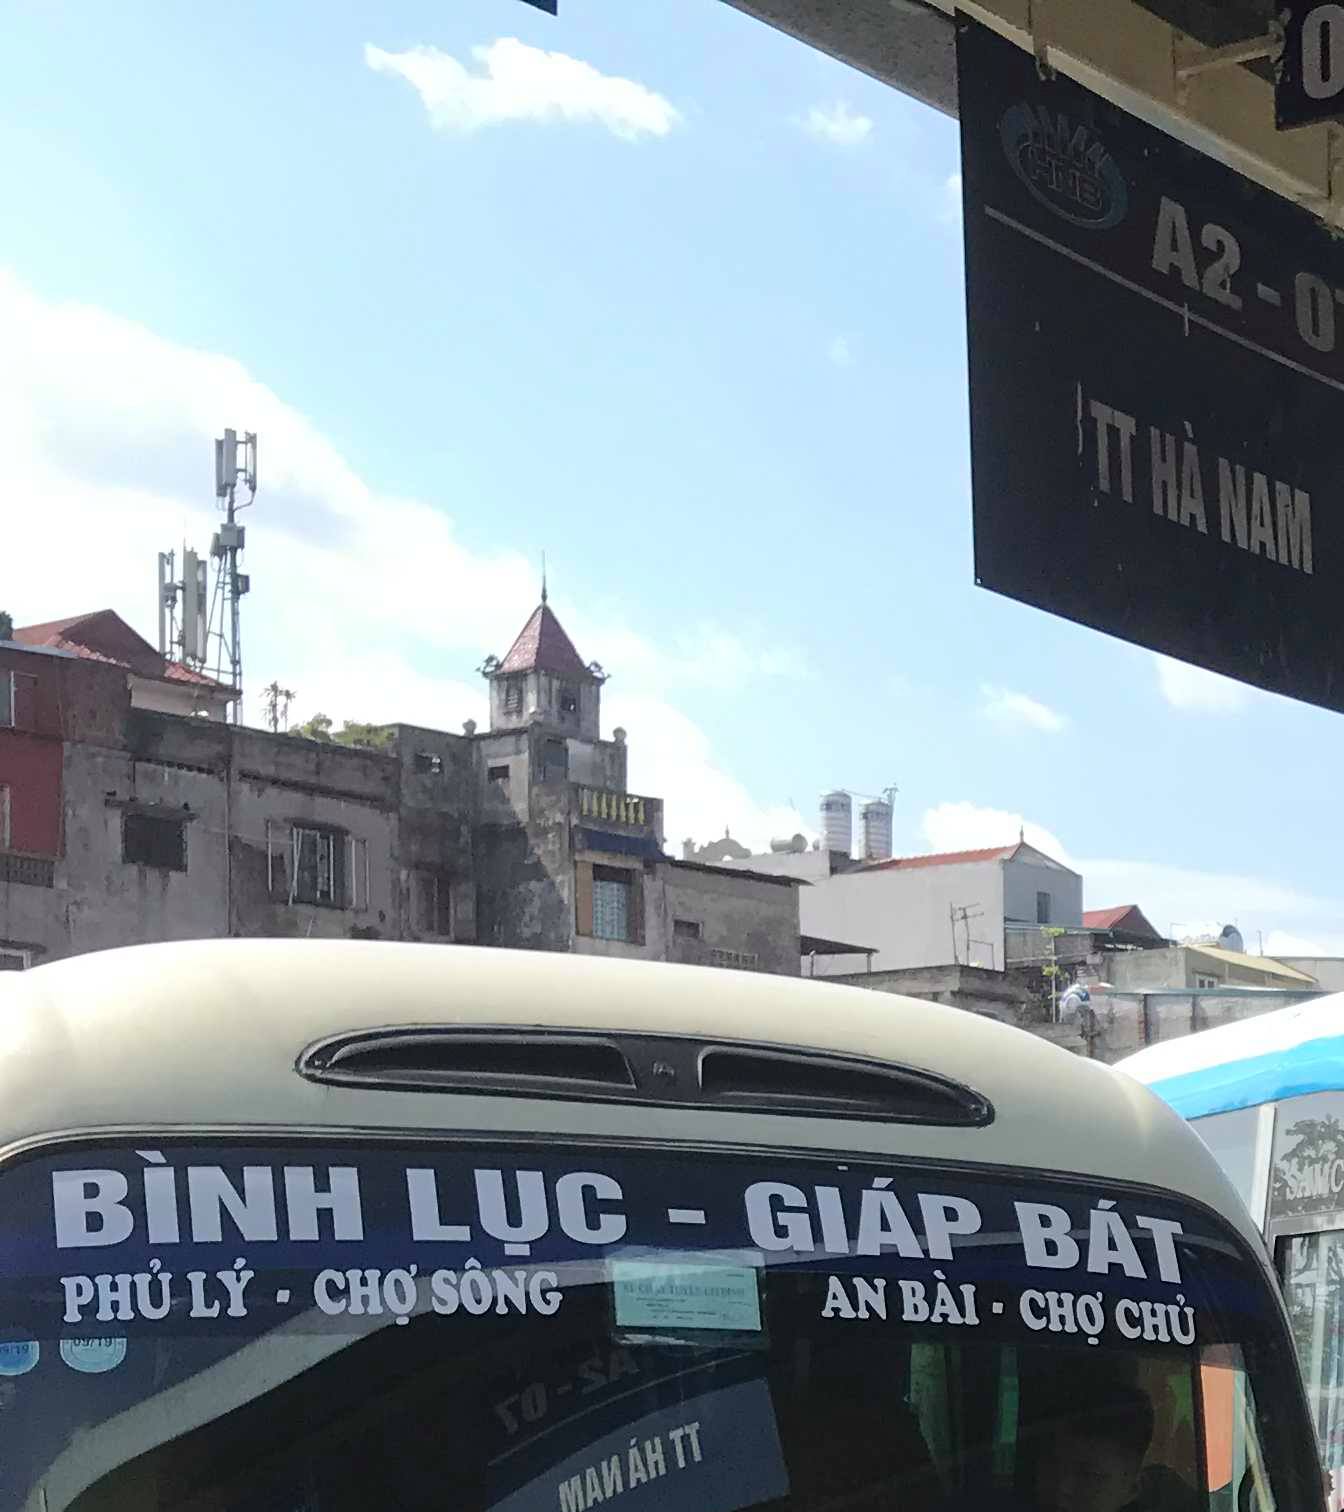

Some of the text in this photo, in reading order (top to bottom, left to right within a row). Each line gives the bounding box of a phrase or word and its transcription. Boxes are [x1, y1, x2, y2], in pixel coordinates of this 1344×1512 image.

[1152, 196, 1243, 311] A2
[1089, 399, 1314, 575] TT HÀ NAM
[52, 1149, 364, 1249] BÌNH
[406, 1166, 627, 1256] LỤC
[744, 1177, 983, 1261] GIÁP
[1014, 1199, 1185, 1285] BÁT
[60, 1259, 175, 1323] PHỦ
[186, 1257, 256, 1318] LÝ
[314, 1264, 419, 1325] CHỢ
[432, 1256, 564, 1316] SÔNG
[821, 1269, 1197, 1345] AN BÀI CHỢ CHỦ
